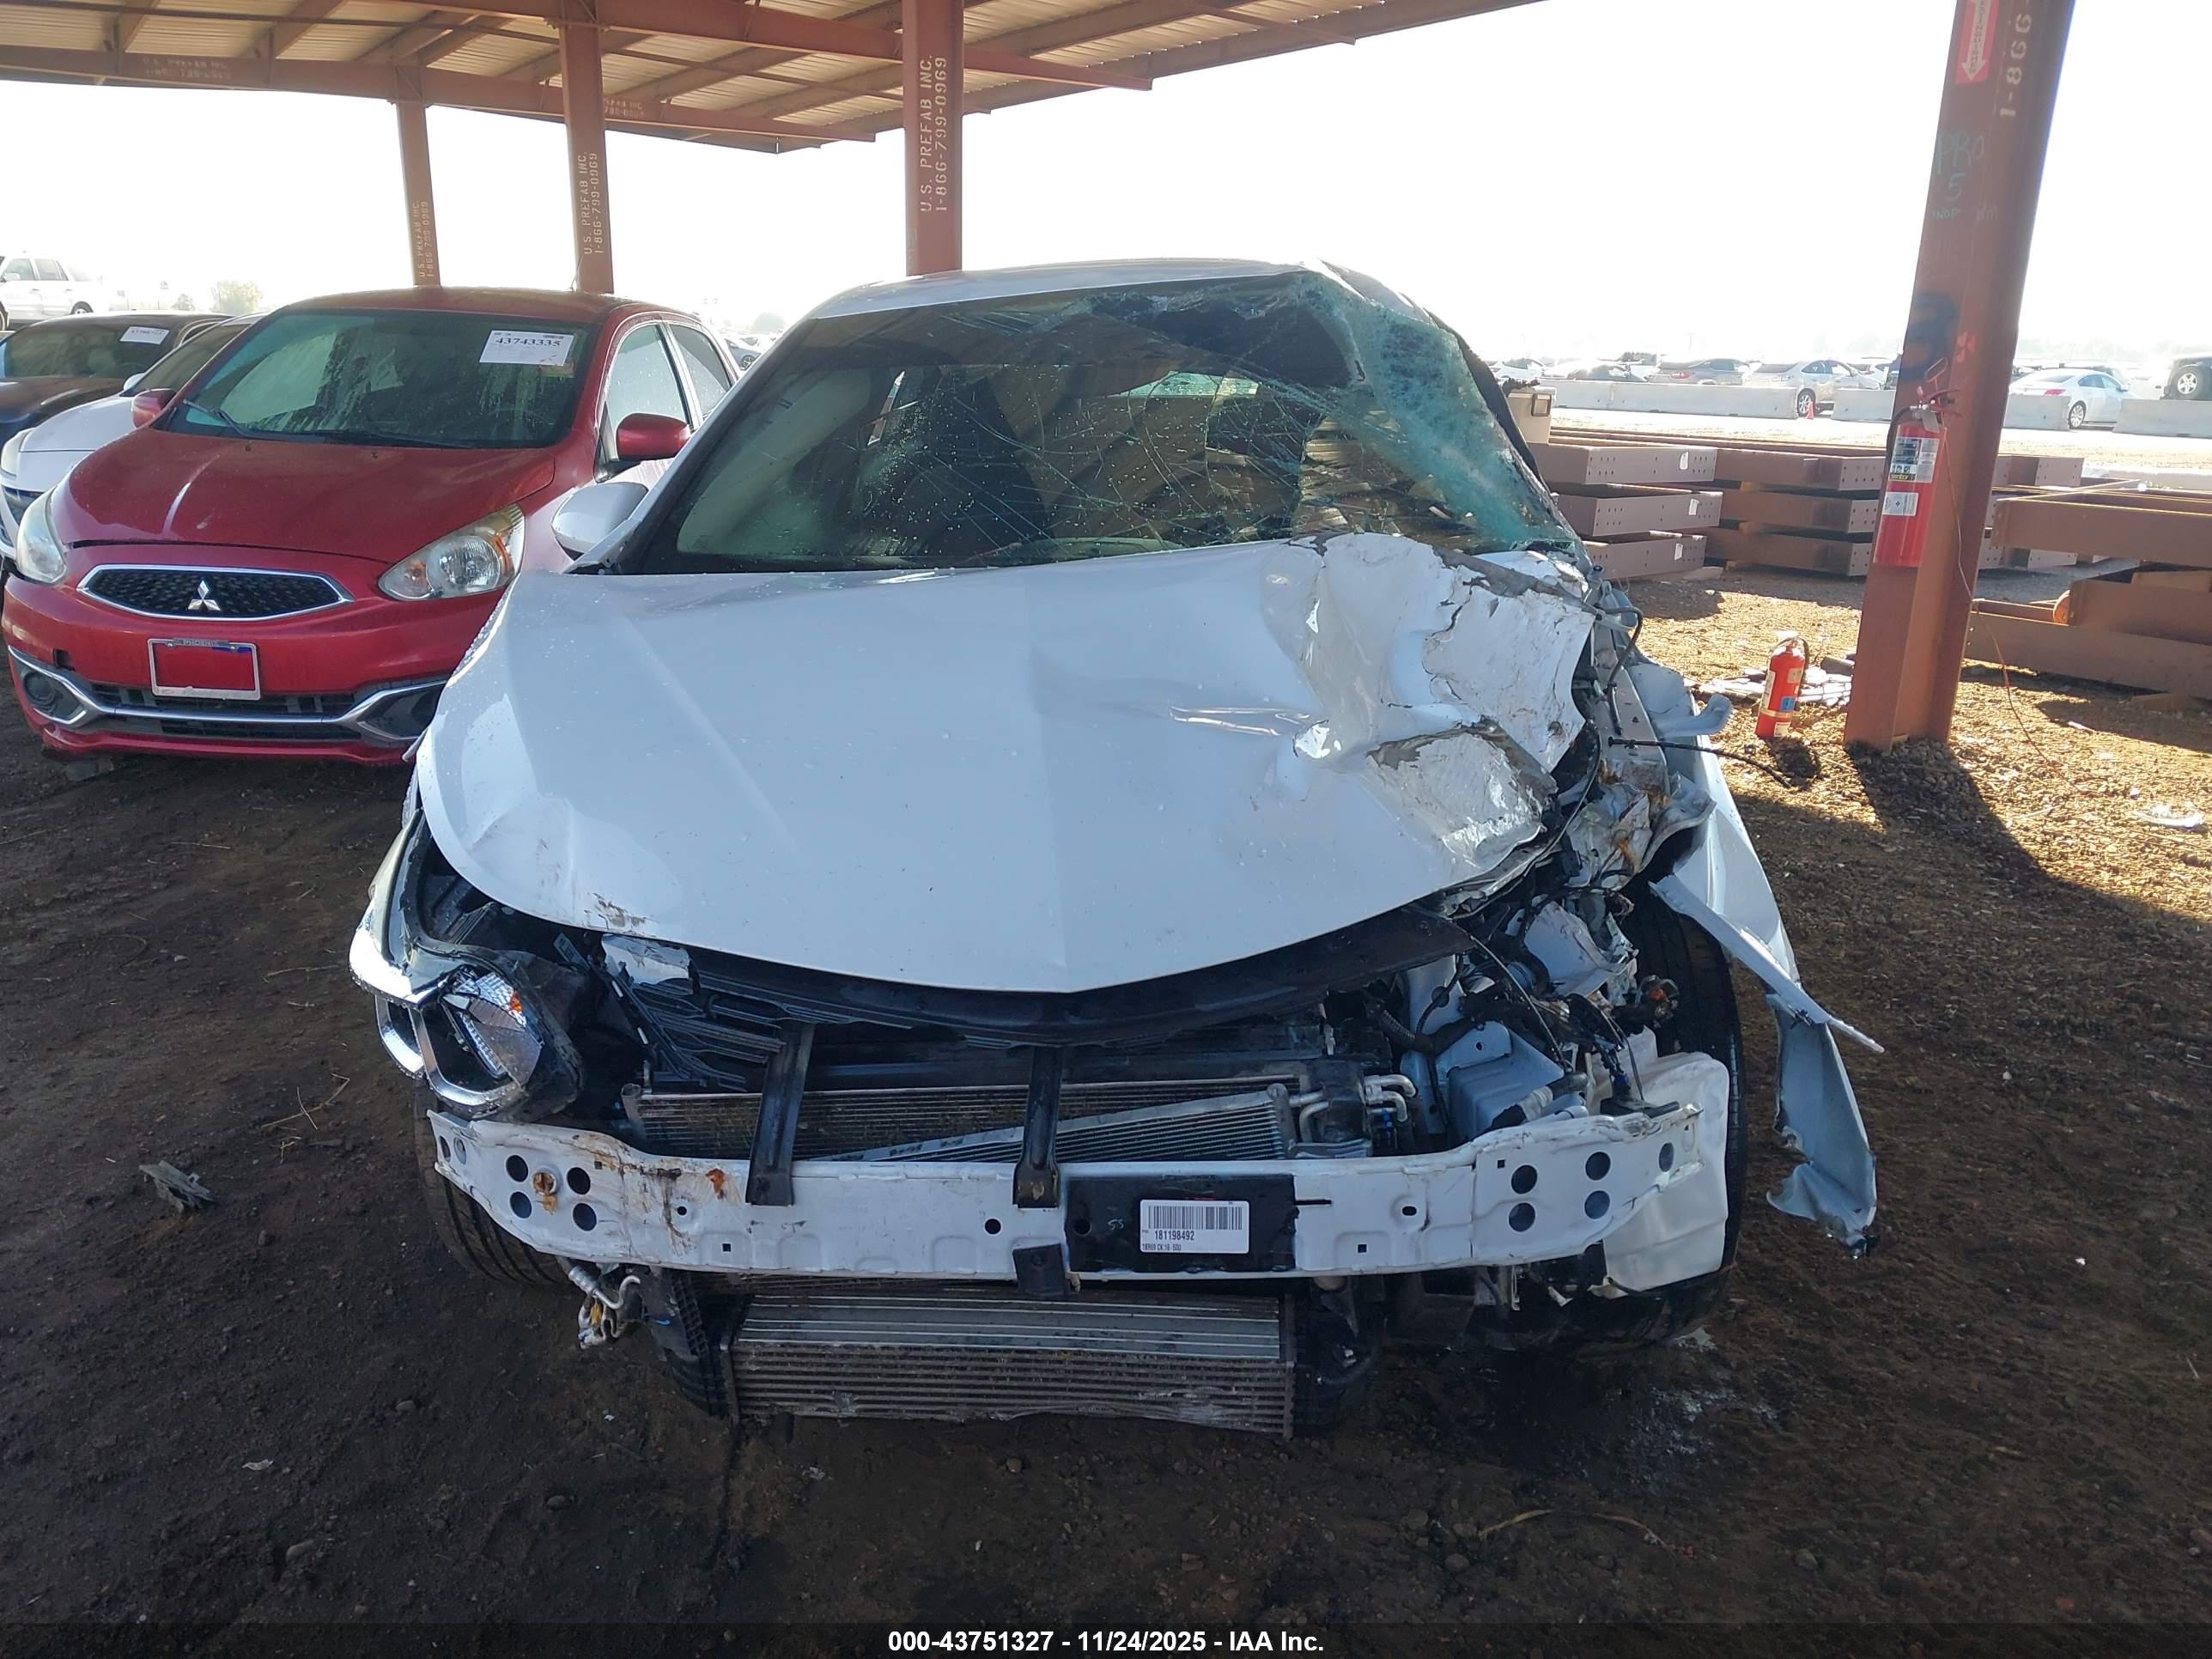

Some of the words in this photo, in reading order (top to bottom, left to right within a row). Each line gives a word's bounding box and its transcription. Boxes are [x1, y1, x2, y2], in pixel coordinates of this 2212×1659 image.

[920, 54, 933, 89] INC.
[920, 97, 933, 169] PREFAB
[934, 57, 948, 212] 1-866-799-0969
[579, 179, 592, 226] PREFAB
[920, 178, 933, 213] U.S.
[495, 336, 562, 347] 43743335
[1155, 1230, 1194, 1241] 181198492
